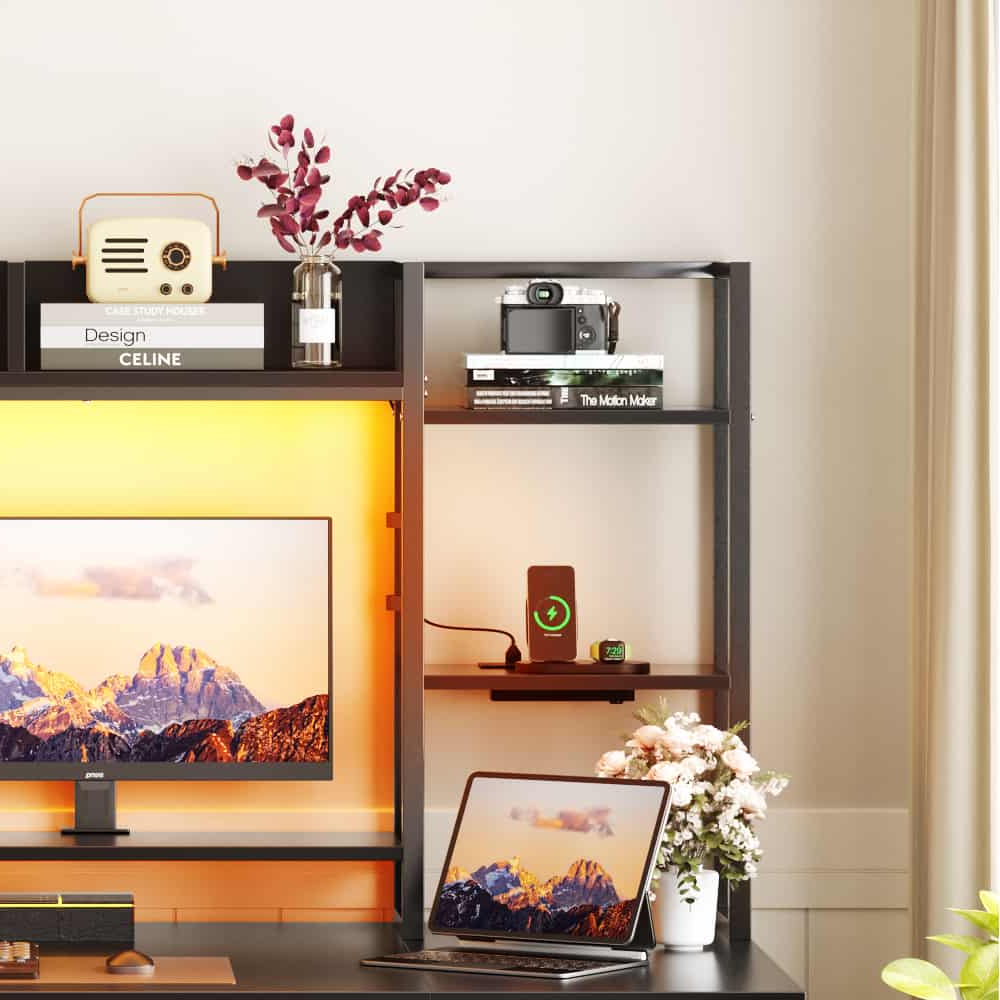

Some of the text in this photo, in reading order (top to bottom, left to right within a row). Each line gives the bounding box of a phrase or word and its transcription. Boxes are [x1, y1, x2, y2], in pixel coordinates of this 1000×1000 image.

[85, 328, 146, 347] Design
[119, 352, 181, 366] CELINE
[580, 394, 597, 406] The
[629, 394, 657, 406] Maker
